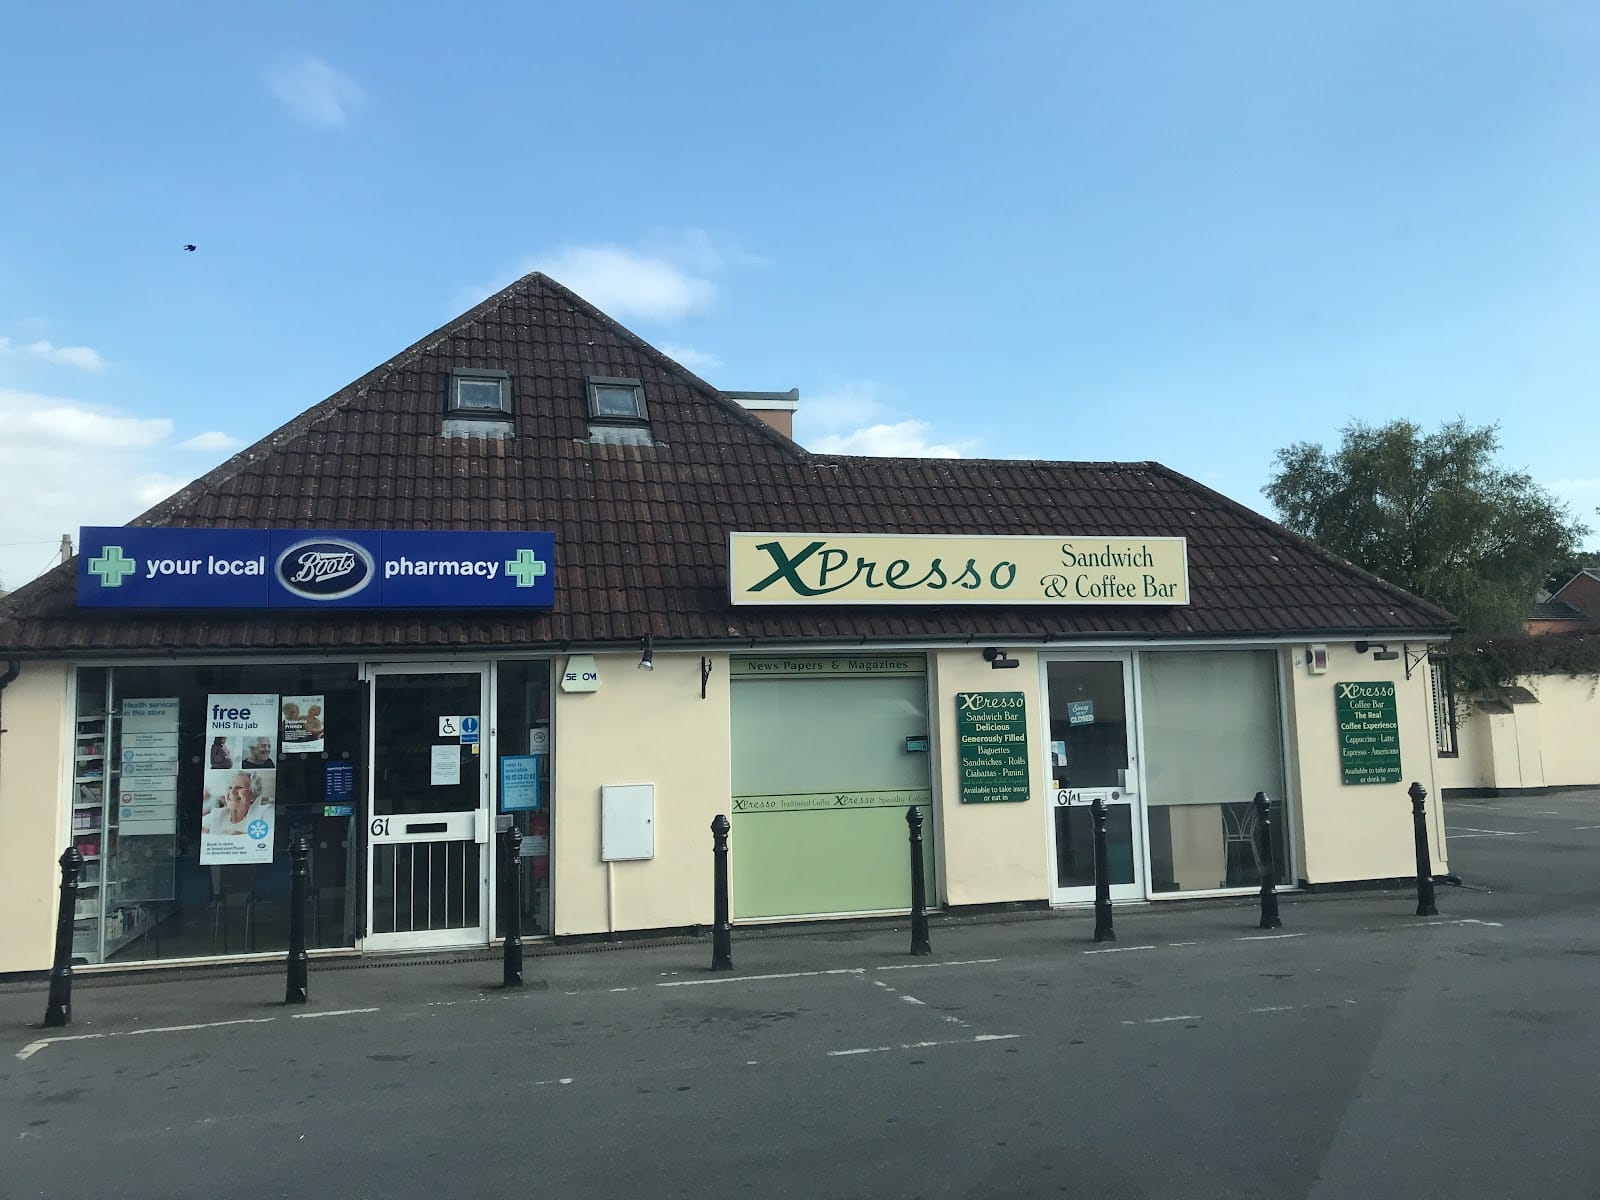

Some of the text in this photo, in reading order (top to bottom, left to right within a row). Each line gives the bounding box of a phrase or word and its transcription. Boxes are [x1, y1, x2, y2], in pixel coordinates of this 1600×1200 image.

[1061, 543, 1154, 567] Sandwich
[146, 551, 499, 583] your local Boots pharmacy
[1040, 574, 1178, 598] & Coffee Bar
[748, 659, 909, 672] News Papers & Magazines
[1349, 700, 1385, 709] Coffee Bar
[212, 704, 251, 720] free
[966, 711, 1019, 721] Sandwich Bar
[1367, 711, 1382, 719] Real
[1070, 714, 1094, 724] CLOSED
[212, 721, 258, 730] NHS flu jab
[975, 723, 1010, 732] Delicious
[1341, 721, 1397, 731] Coffee Experience
[961, 733, 1025, 744] Generously Filled
[1345, 734, 1377, 744] Cappuccino
[1380, 734, 1395, 743] Latte
[977, 745, 1010, 755] Baguettes
[1342, 747, 1367, 758] Espresso
[963, 757, 1002, 767] Sandwiches
[1008, 756, 1026, 766] Rolls
[965, 768, 997, 777] Ciabattas
[1002, 767, 1024, 777] Panini
[1345, 766, 1368, 775] Available
[963, 785, 990, 794] Available
[998, 785, 1012, 793] take
[1002, 793, 1009, 801] in
[370, 817, 390, 836] 61
